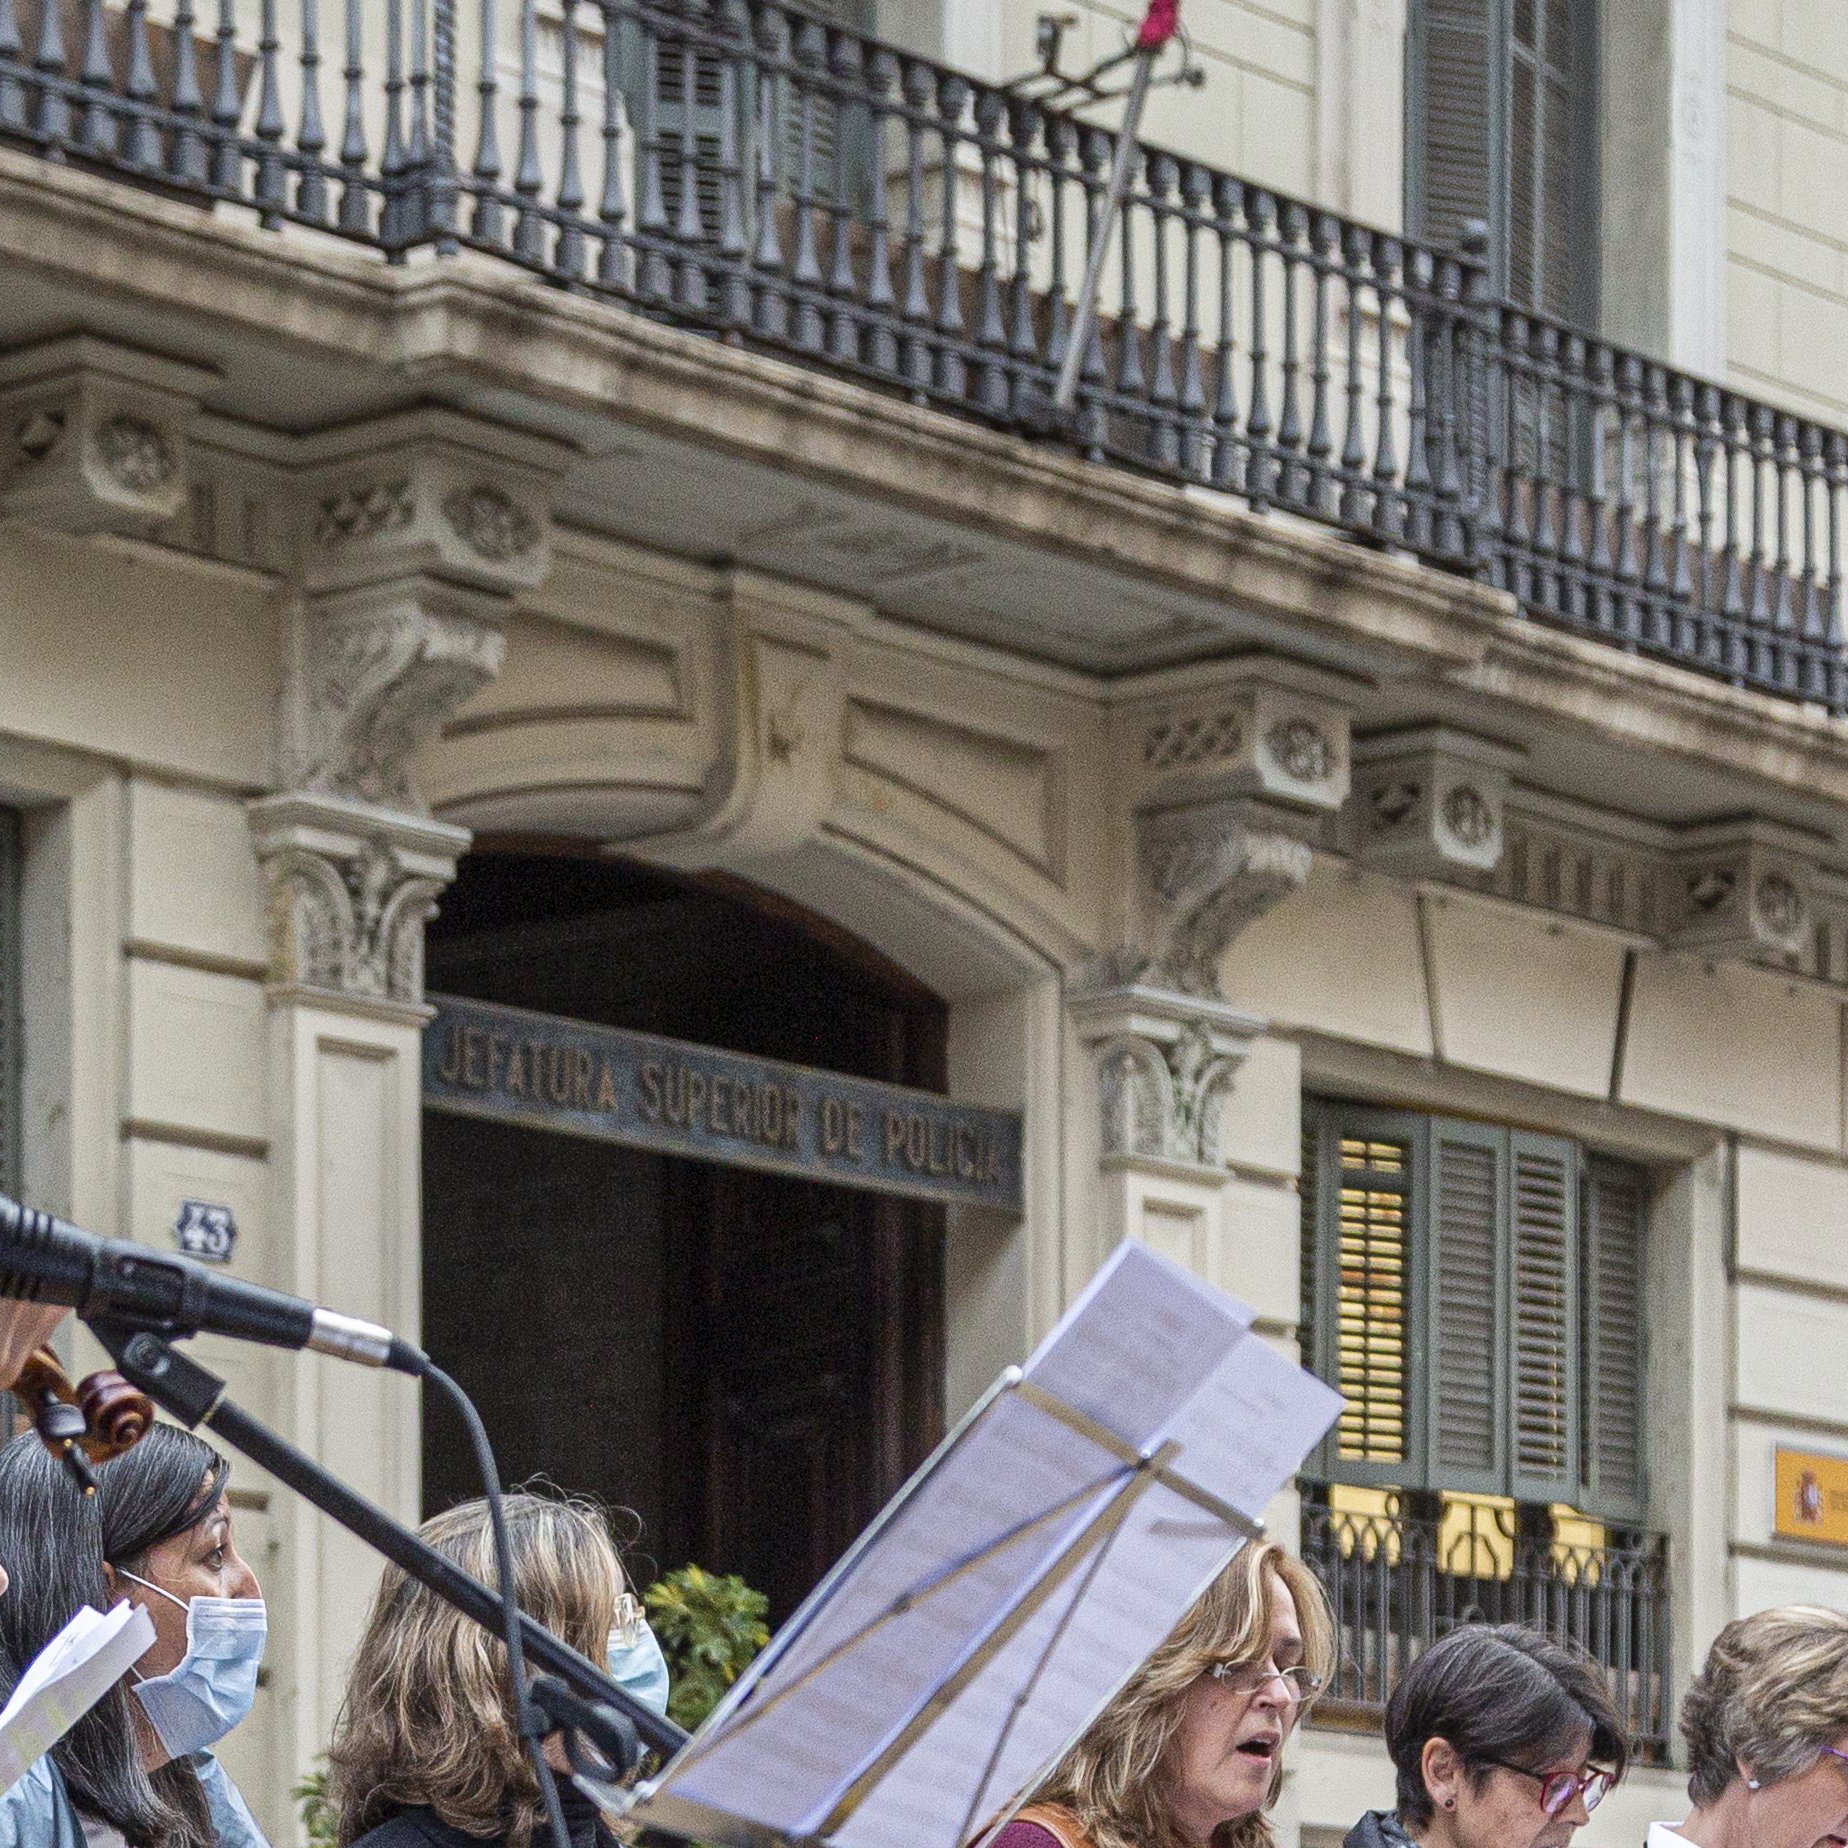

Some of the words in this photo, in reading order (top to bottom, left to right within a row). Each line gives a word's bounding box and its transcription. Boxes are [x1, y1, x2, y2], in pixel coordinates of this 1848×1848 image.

[438, 1027, 619, 1111] JEFATURA
[639, 1064, 803, 1150] SUPERIOR
[820, 1098, 866, 1162] DE
